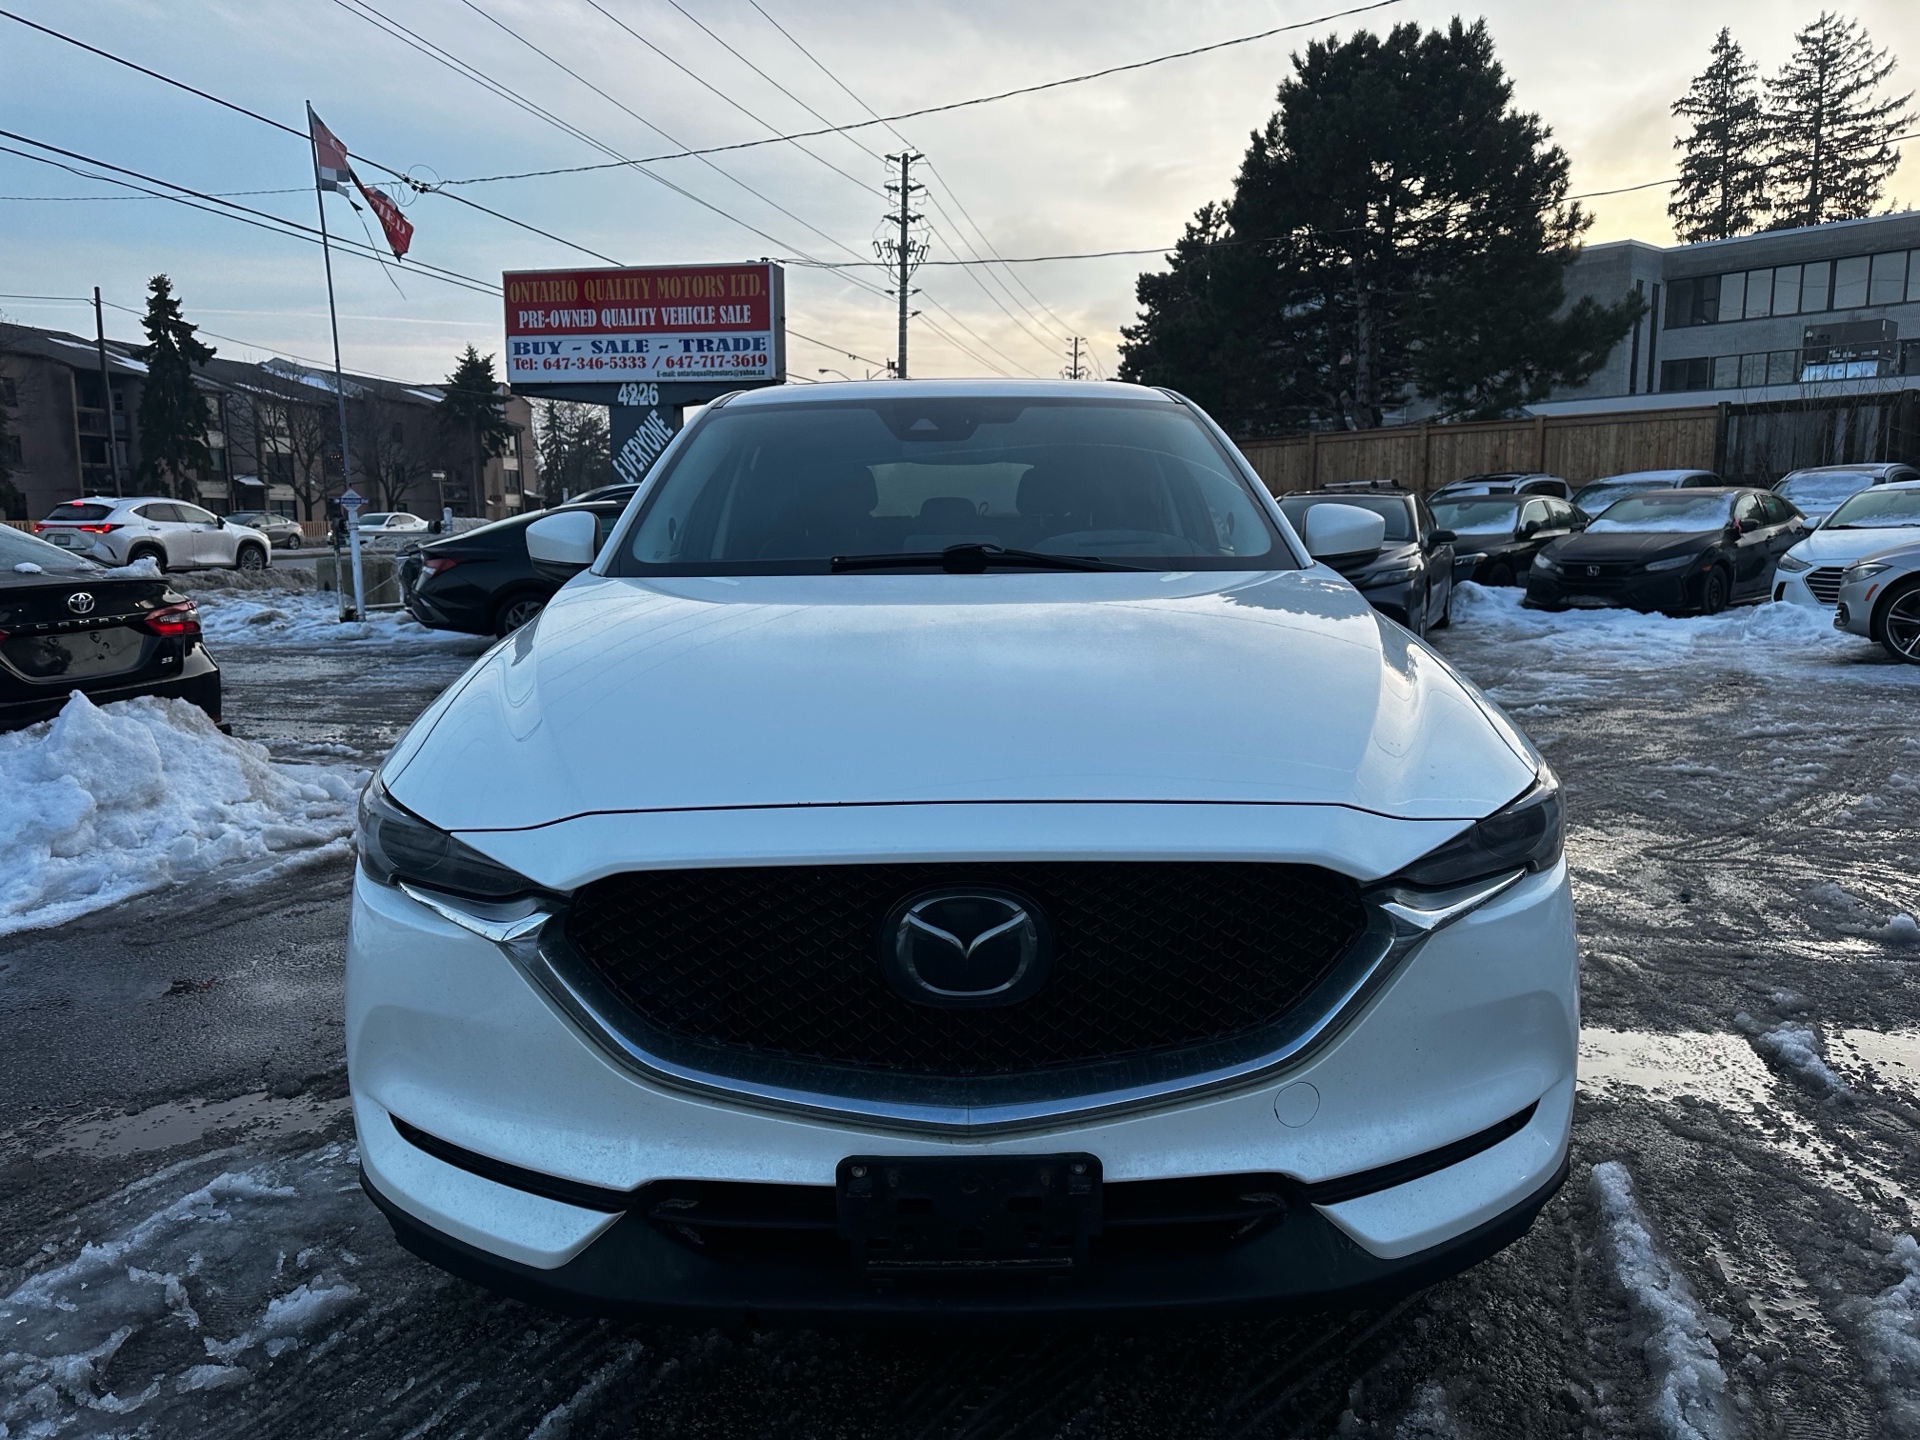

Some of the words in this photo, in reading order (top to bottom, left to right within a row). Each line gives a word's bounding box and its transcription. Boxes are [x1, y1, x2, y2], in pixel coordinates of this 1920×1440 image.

[509, 279, 578, 304] ONTARIO
[584, 277, 651, 303] QUALITY
[657, 275, 725, 299] MOTORS
[730, 273, 766, 297] LTD.
[518, 308, 597, 329] PRE-OWNED
[601, 307, 657, 329] QUALITY
[661, 305, 716, 326] VEHICLE
[720, 304, 751, 325] SALE
[513, 341, 562, 355] BUY
[591, 339, 650, 354] SALE
[679, 337, 767, 353] TRADE
[513, 357, 538, 371] Tel:
[542, 355, 647, 371] 647-346-5333
[665, 353, 768, 369] 647-717-3619
[617, 382, 659, 406] 4226
[611, 409, 674, 484] EVERYONE
[36, 615, 126, 630] CAMRY
